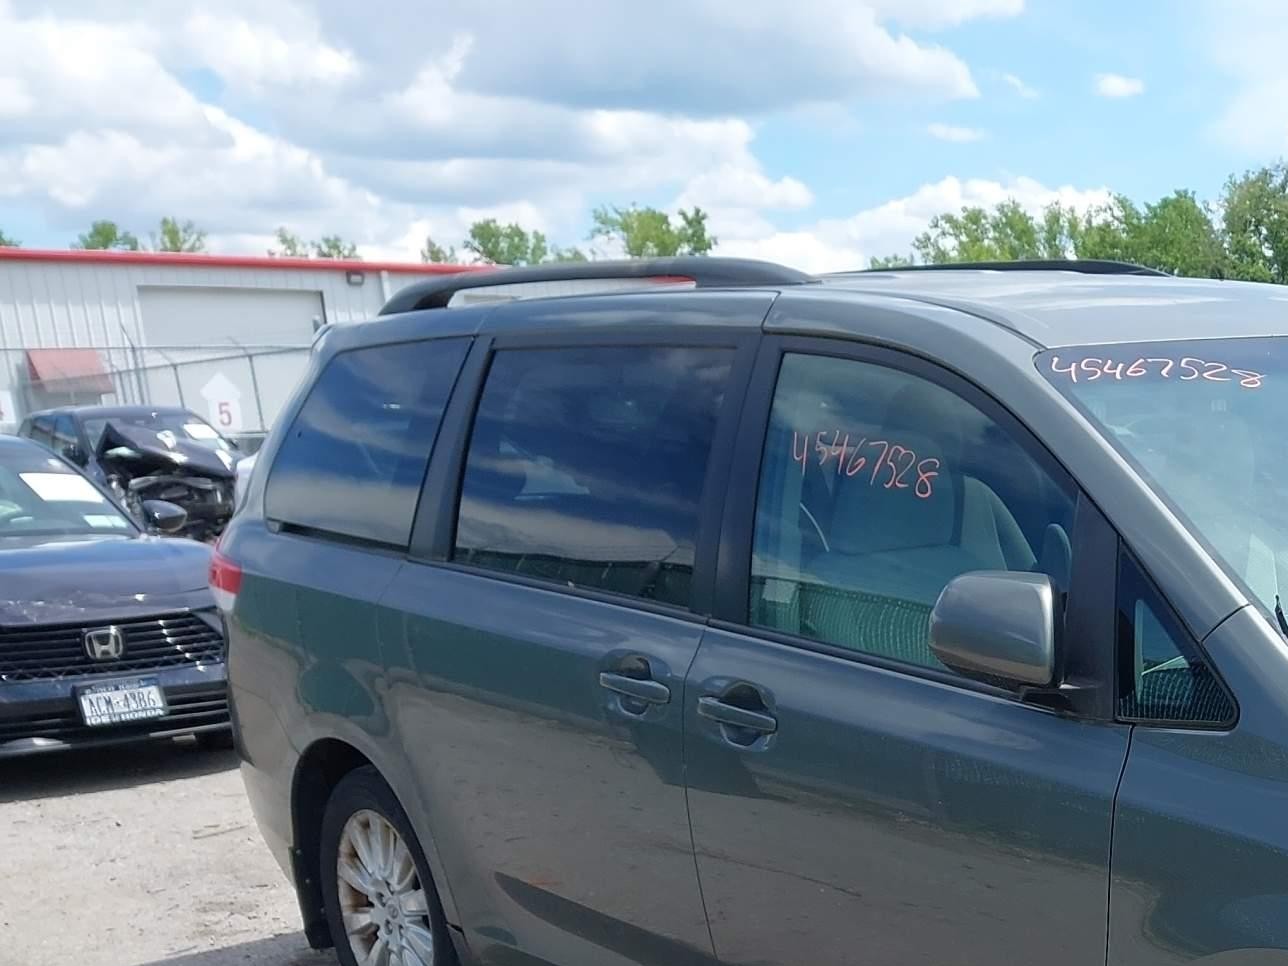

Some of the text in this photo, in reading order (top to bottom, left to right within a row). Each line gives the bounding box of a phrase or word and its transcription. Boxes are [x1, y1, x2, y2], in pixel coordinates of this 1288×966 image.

[1051, 356, 1268, 388] 45467528
[218, 402, 232, 427] 5
[793, 430, 940, 498] 45467528
